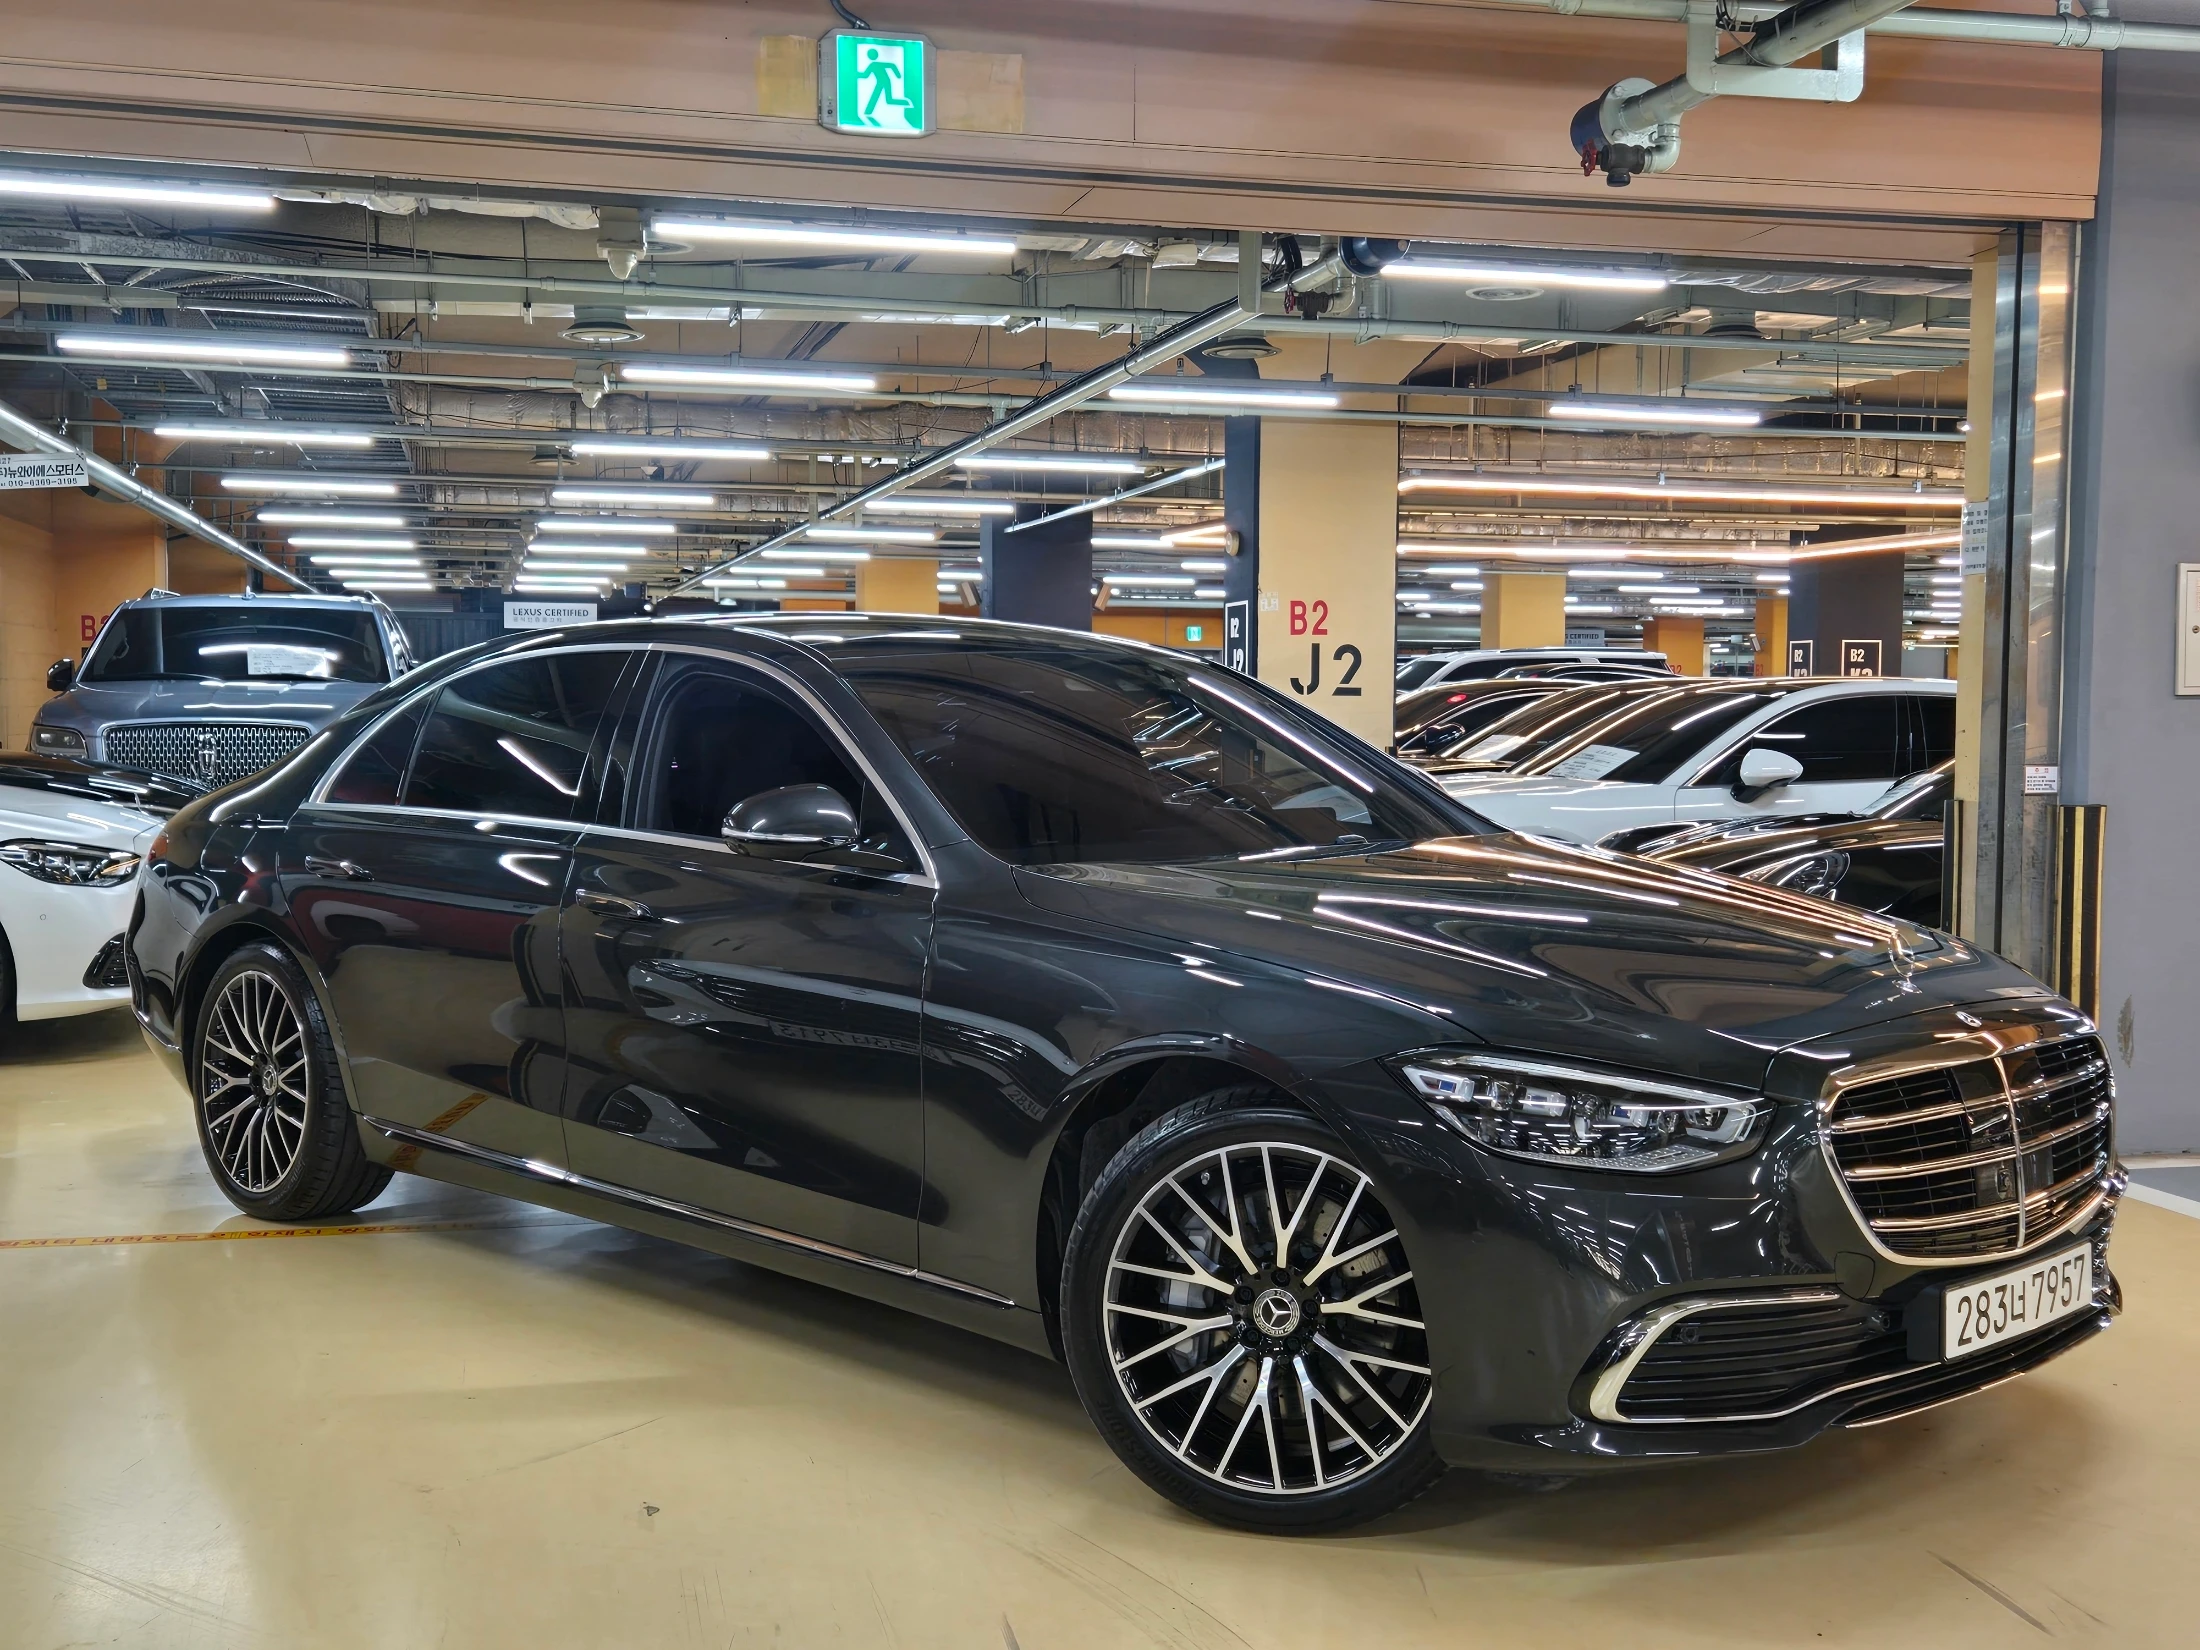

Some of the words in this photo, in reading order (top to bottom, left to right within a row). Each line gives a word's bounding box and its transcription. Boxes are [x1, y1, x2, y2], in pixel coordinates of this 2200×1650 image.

[512, 608, 542, 616] LEXUS
[544, 608, 589, 617] CERTIFIED
[1290, 600, 1328, 635] B2
[1230, 618, 1239, 638] B2
[1794, 649, 1803, 662] B2
[1850, 648, 1865, 662] B2
[1290, 643, 1362, 696] J2
[1957, 1280, 2026, 1347] 283너
[2032, 1253, 2086, 1320] 7957
